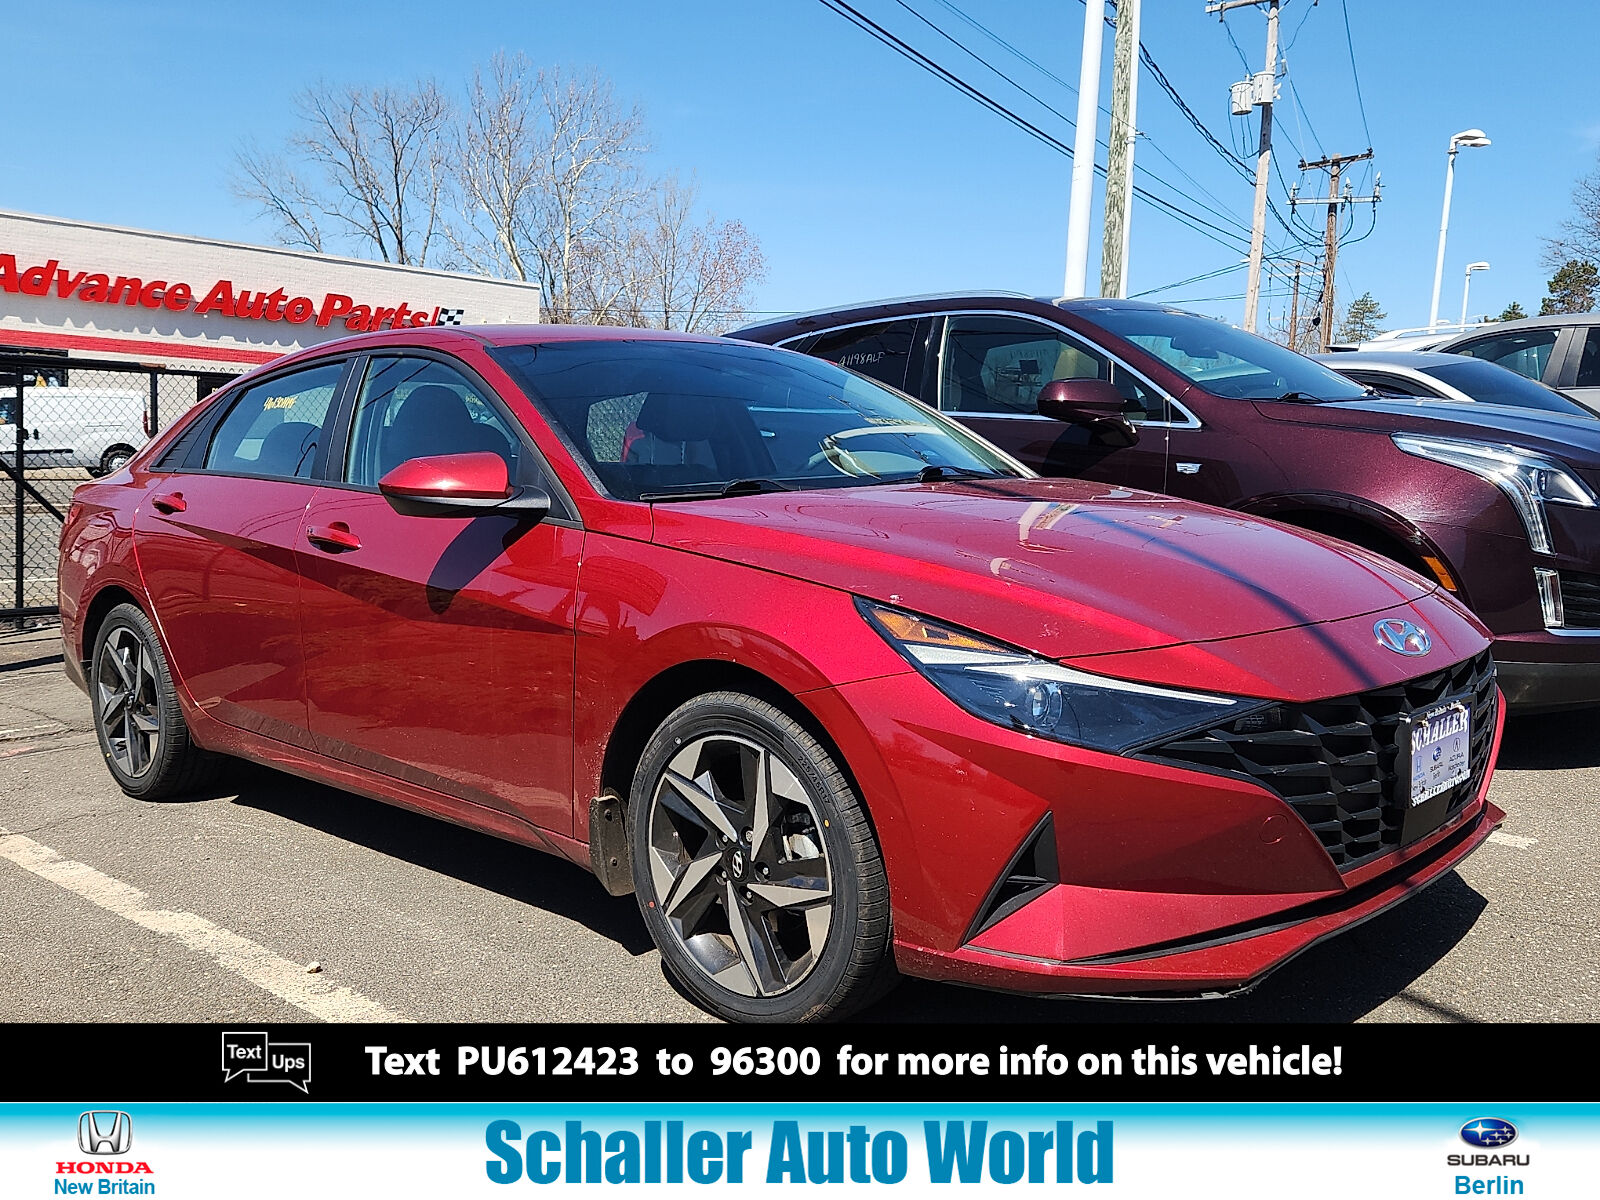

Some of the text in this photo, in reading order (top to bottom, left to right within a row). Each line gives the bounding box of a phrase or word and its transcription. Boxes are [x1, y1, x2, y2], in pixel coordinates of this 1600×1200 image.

[0, 254, 430, 332] Advance Auto Parts
[1411, 709, 1469, 755] SCHALLER
